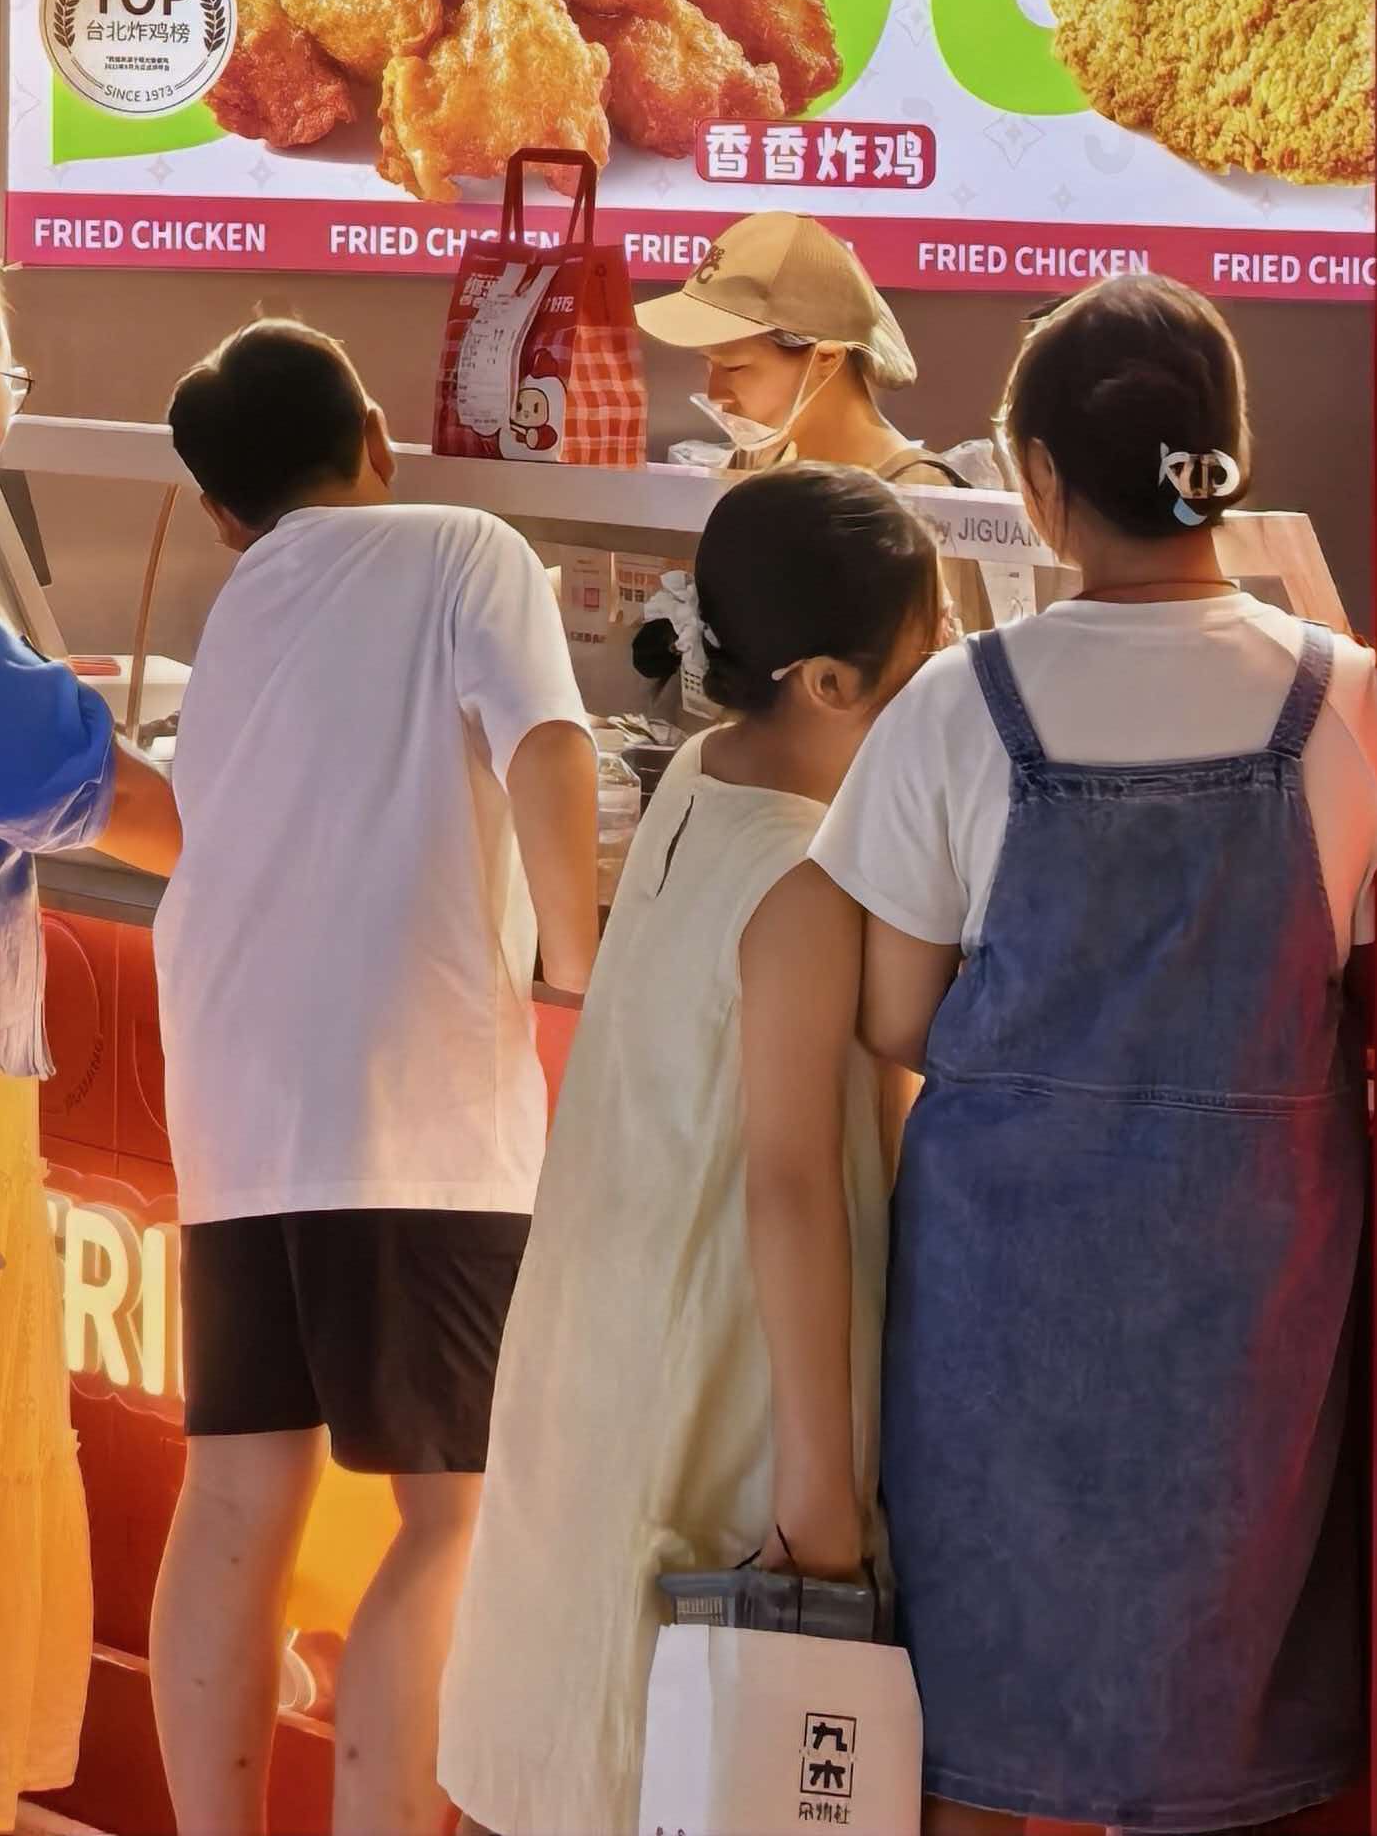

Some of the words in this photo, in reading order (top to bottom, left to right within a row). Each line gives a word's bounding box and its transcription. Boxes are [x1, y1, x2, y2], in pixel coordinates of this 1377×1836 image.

[86, 20, 191, 44] 台北炸鸡榜
[104, 84, 141, 102] SINCE
[144, 86, 174, 102] 1973
[705, 124, 925, 186] 香香炸鸡
[34, 216, 124, 249] FRIED
[130, 219, 266, 253] CHICKEN
[329, 225, 419, 256] FRIED
[624, 232, 712, 264] FRIED
[918, 242, 1008, 275] FRIED
[1014, 246, 1149, 277] CHICKEN
[1213, 251, 1302, 284] FRIED
[809, 1721, 848, 1789] 九木
